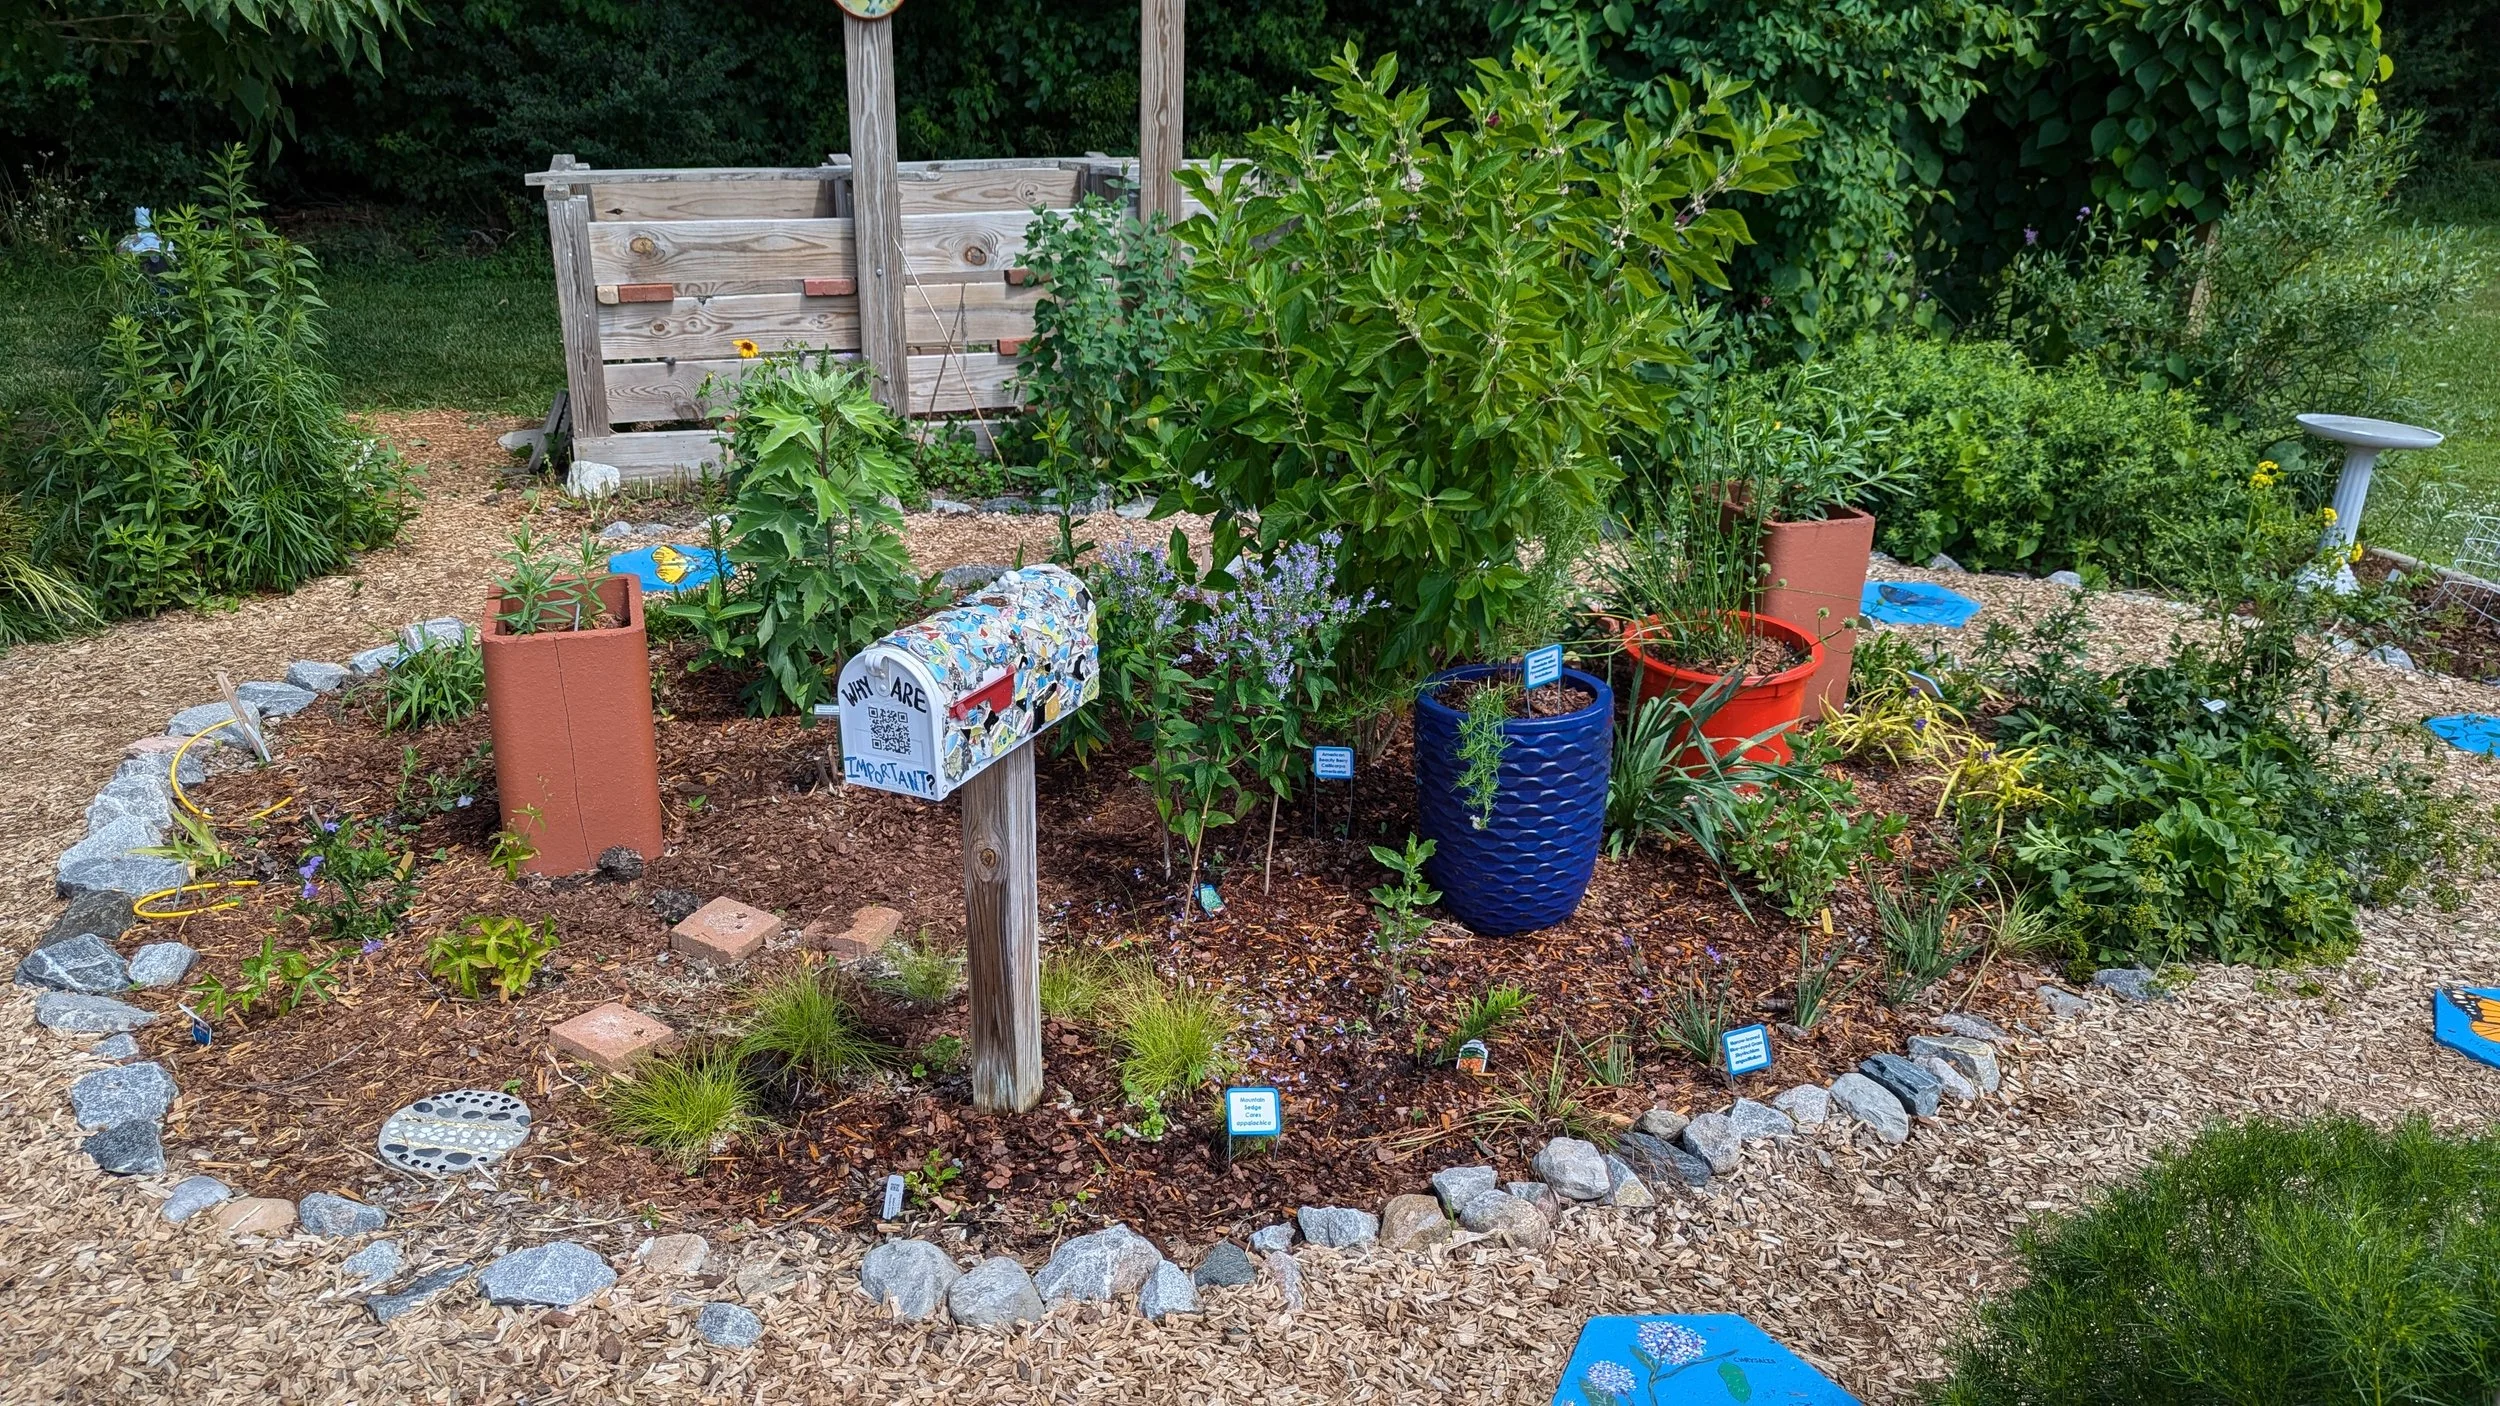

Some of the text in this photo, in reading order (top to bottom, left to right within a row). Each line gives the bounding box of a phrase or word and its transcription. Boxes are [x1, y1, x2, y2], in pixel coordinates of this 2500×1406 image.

[841, 676, 927, 713] WHY ARE
[844, 756, 936, 796] IMPORTANT?
